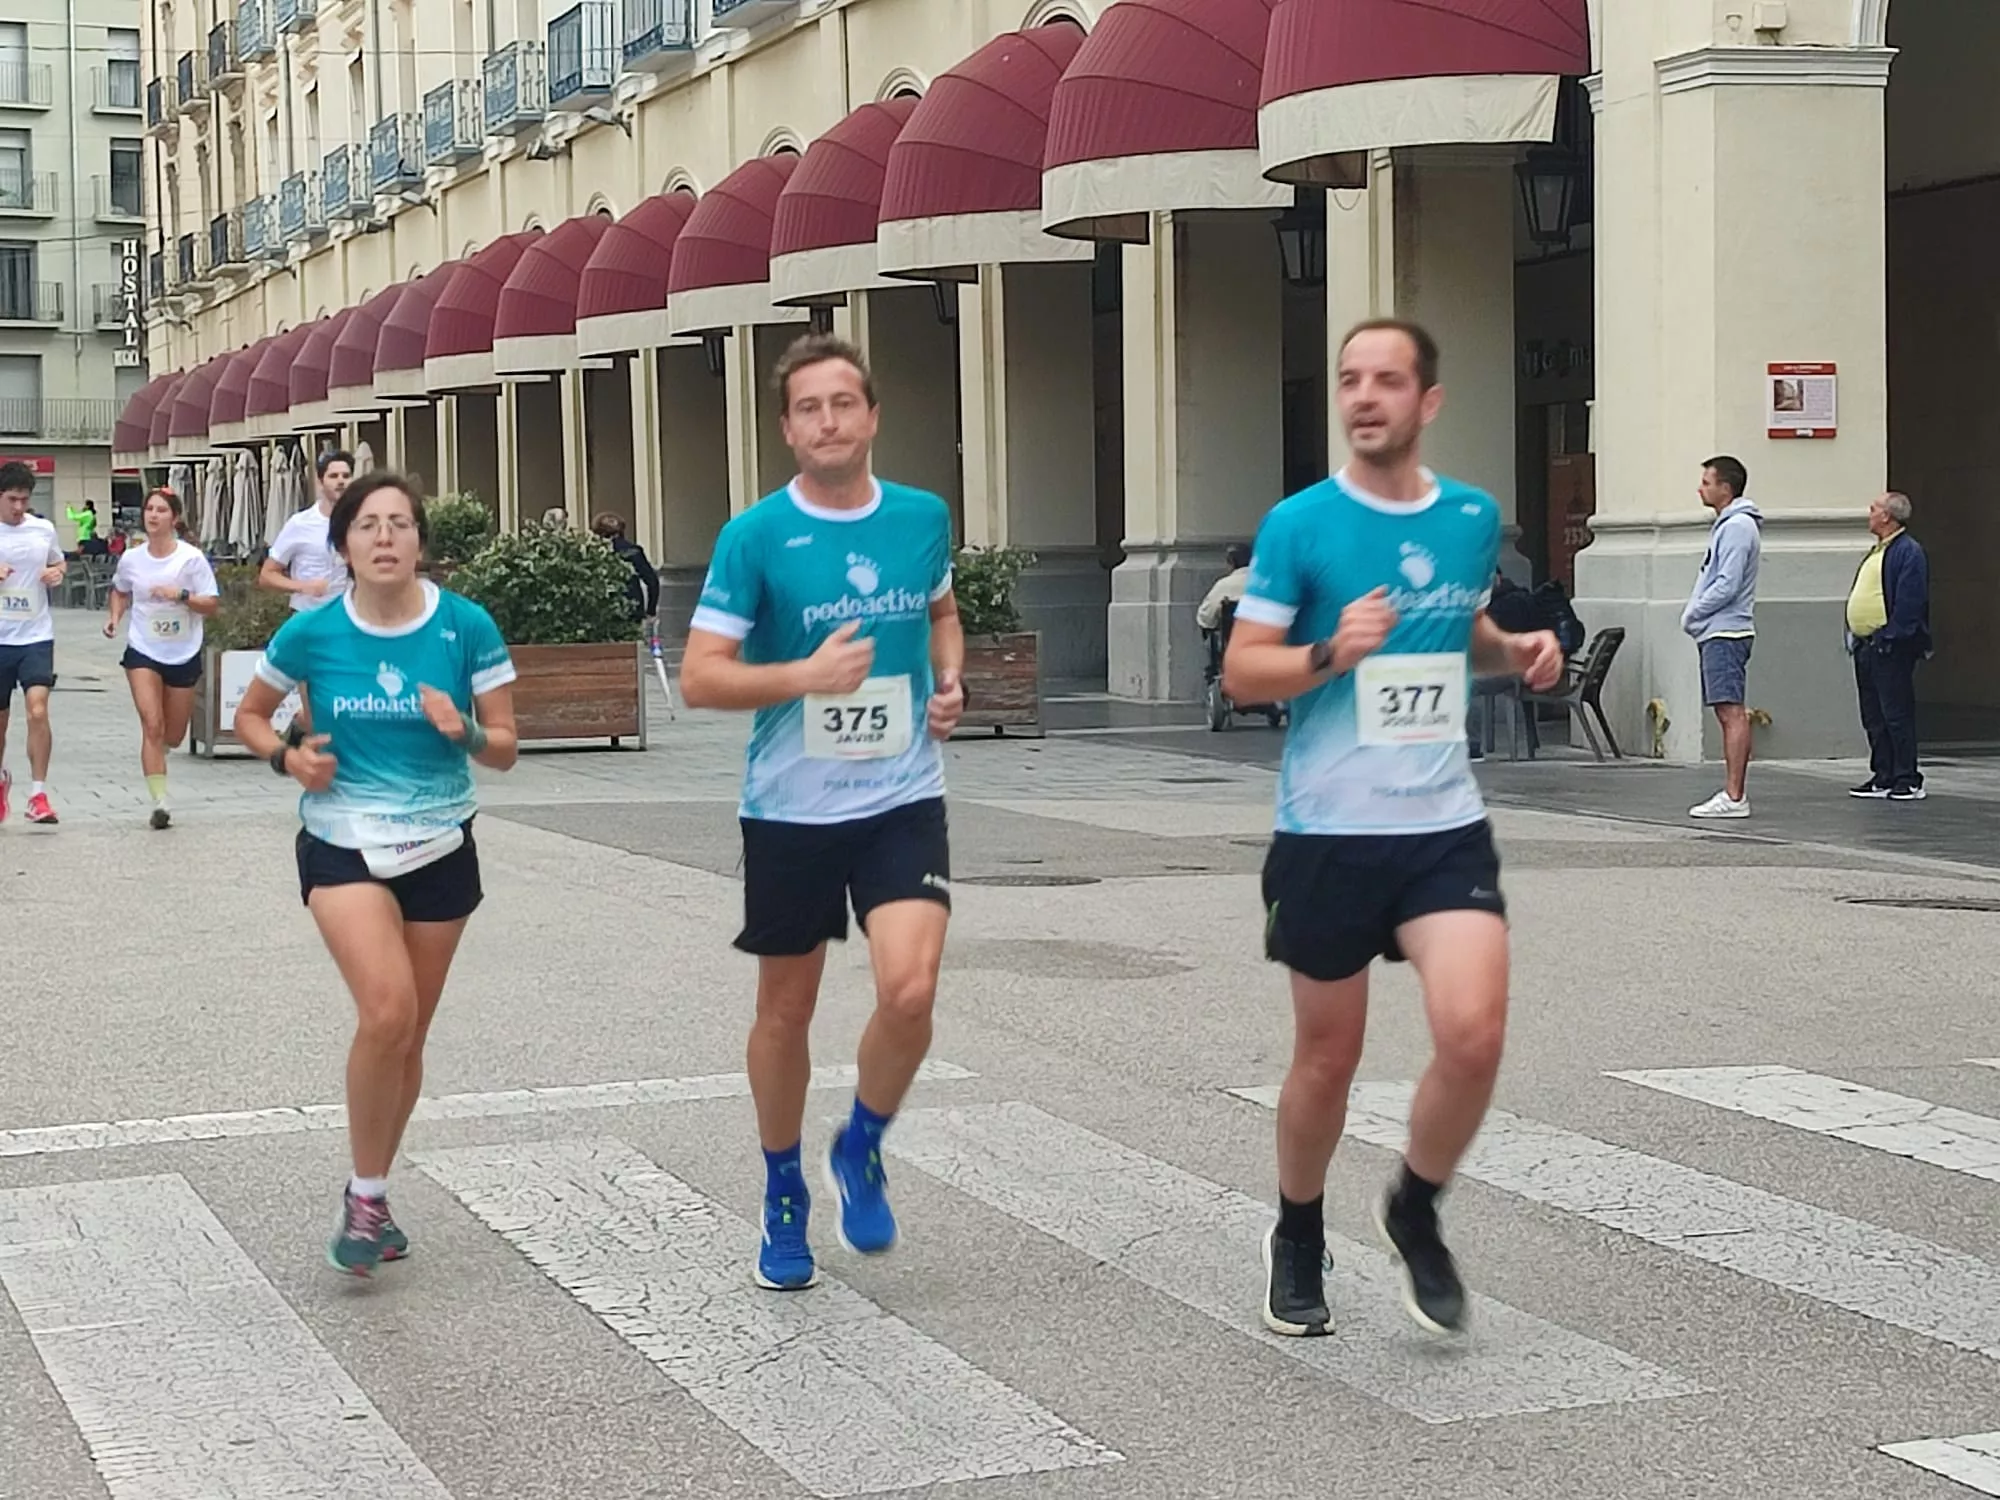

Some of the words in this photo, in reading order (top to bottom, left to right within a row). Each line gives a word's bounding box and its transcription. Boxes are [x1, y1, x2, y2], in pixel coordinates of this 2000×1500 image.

[122, 239, 138, 346] HOSTAL
[802, 588, 926, 634] podoactiva
[1379, 684, 1445, 714] 377
[823, 704, 889, 733] 375
